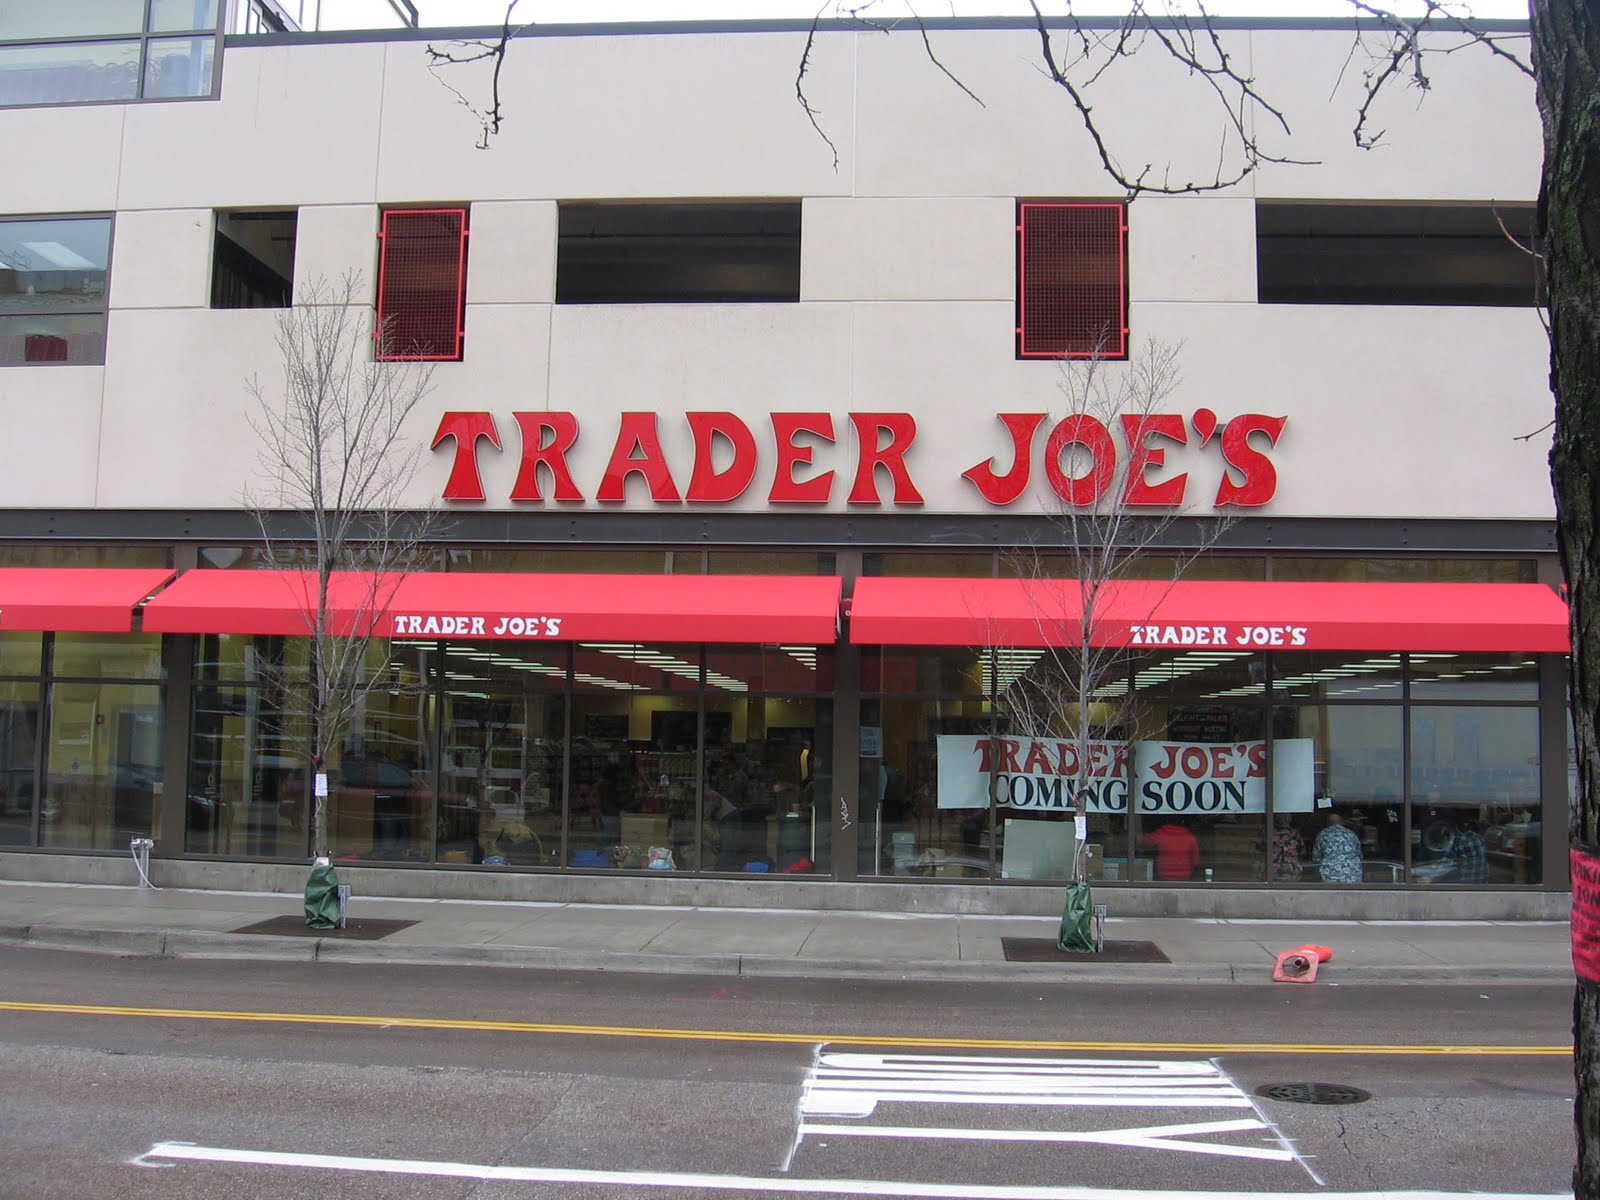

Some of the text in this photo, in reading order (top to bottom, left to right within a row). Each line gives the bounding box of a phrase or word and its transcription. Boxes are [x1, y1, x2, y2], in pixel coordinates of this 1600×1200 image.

[430, 408, 1289, 507] TRADER JOE'S
[394, 615, 562, 636] TRADER JOE'S
[1129, 625, 1308, 646] TRADER JOE'S
[973, 739, 1267, 779] TRADER JOE'S
[989, 774, 1247, 812] COMING SOON
